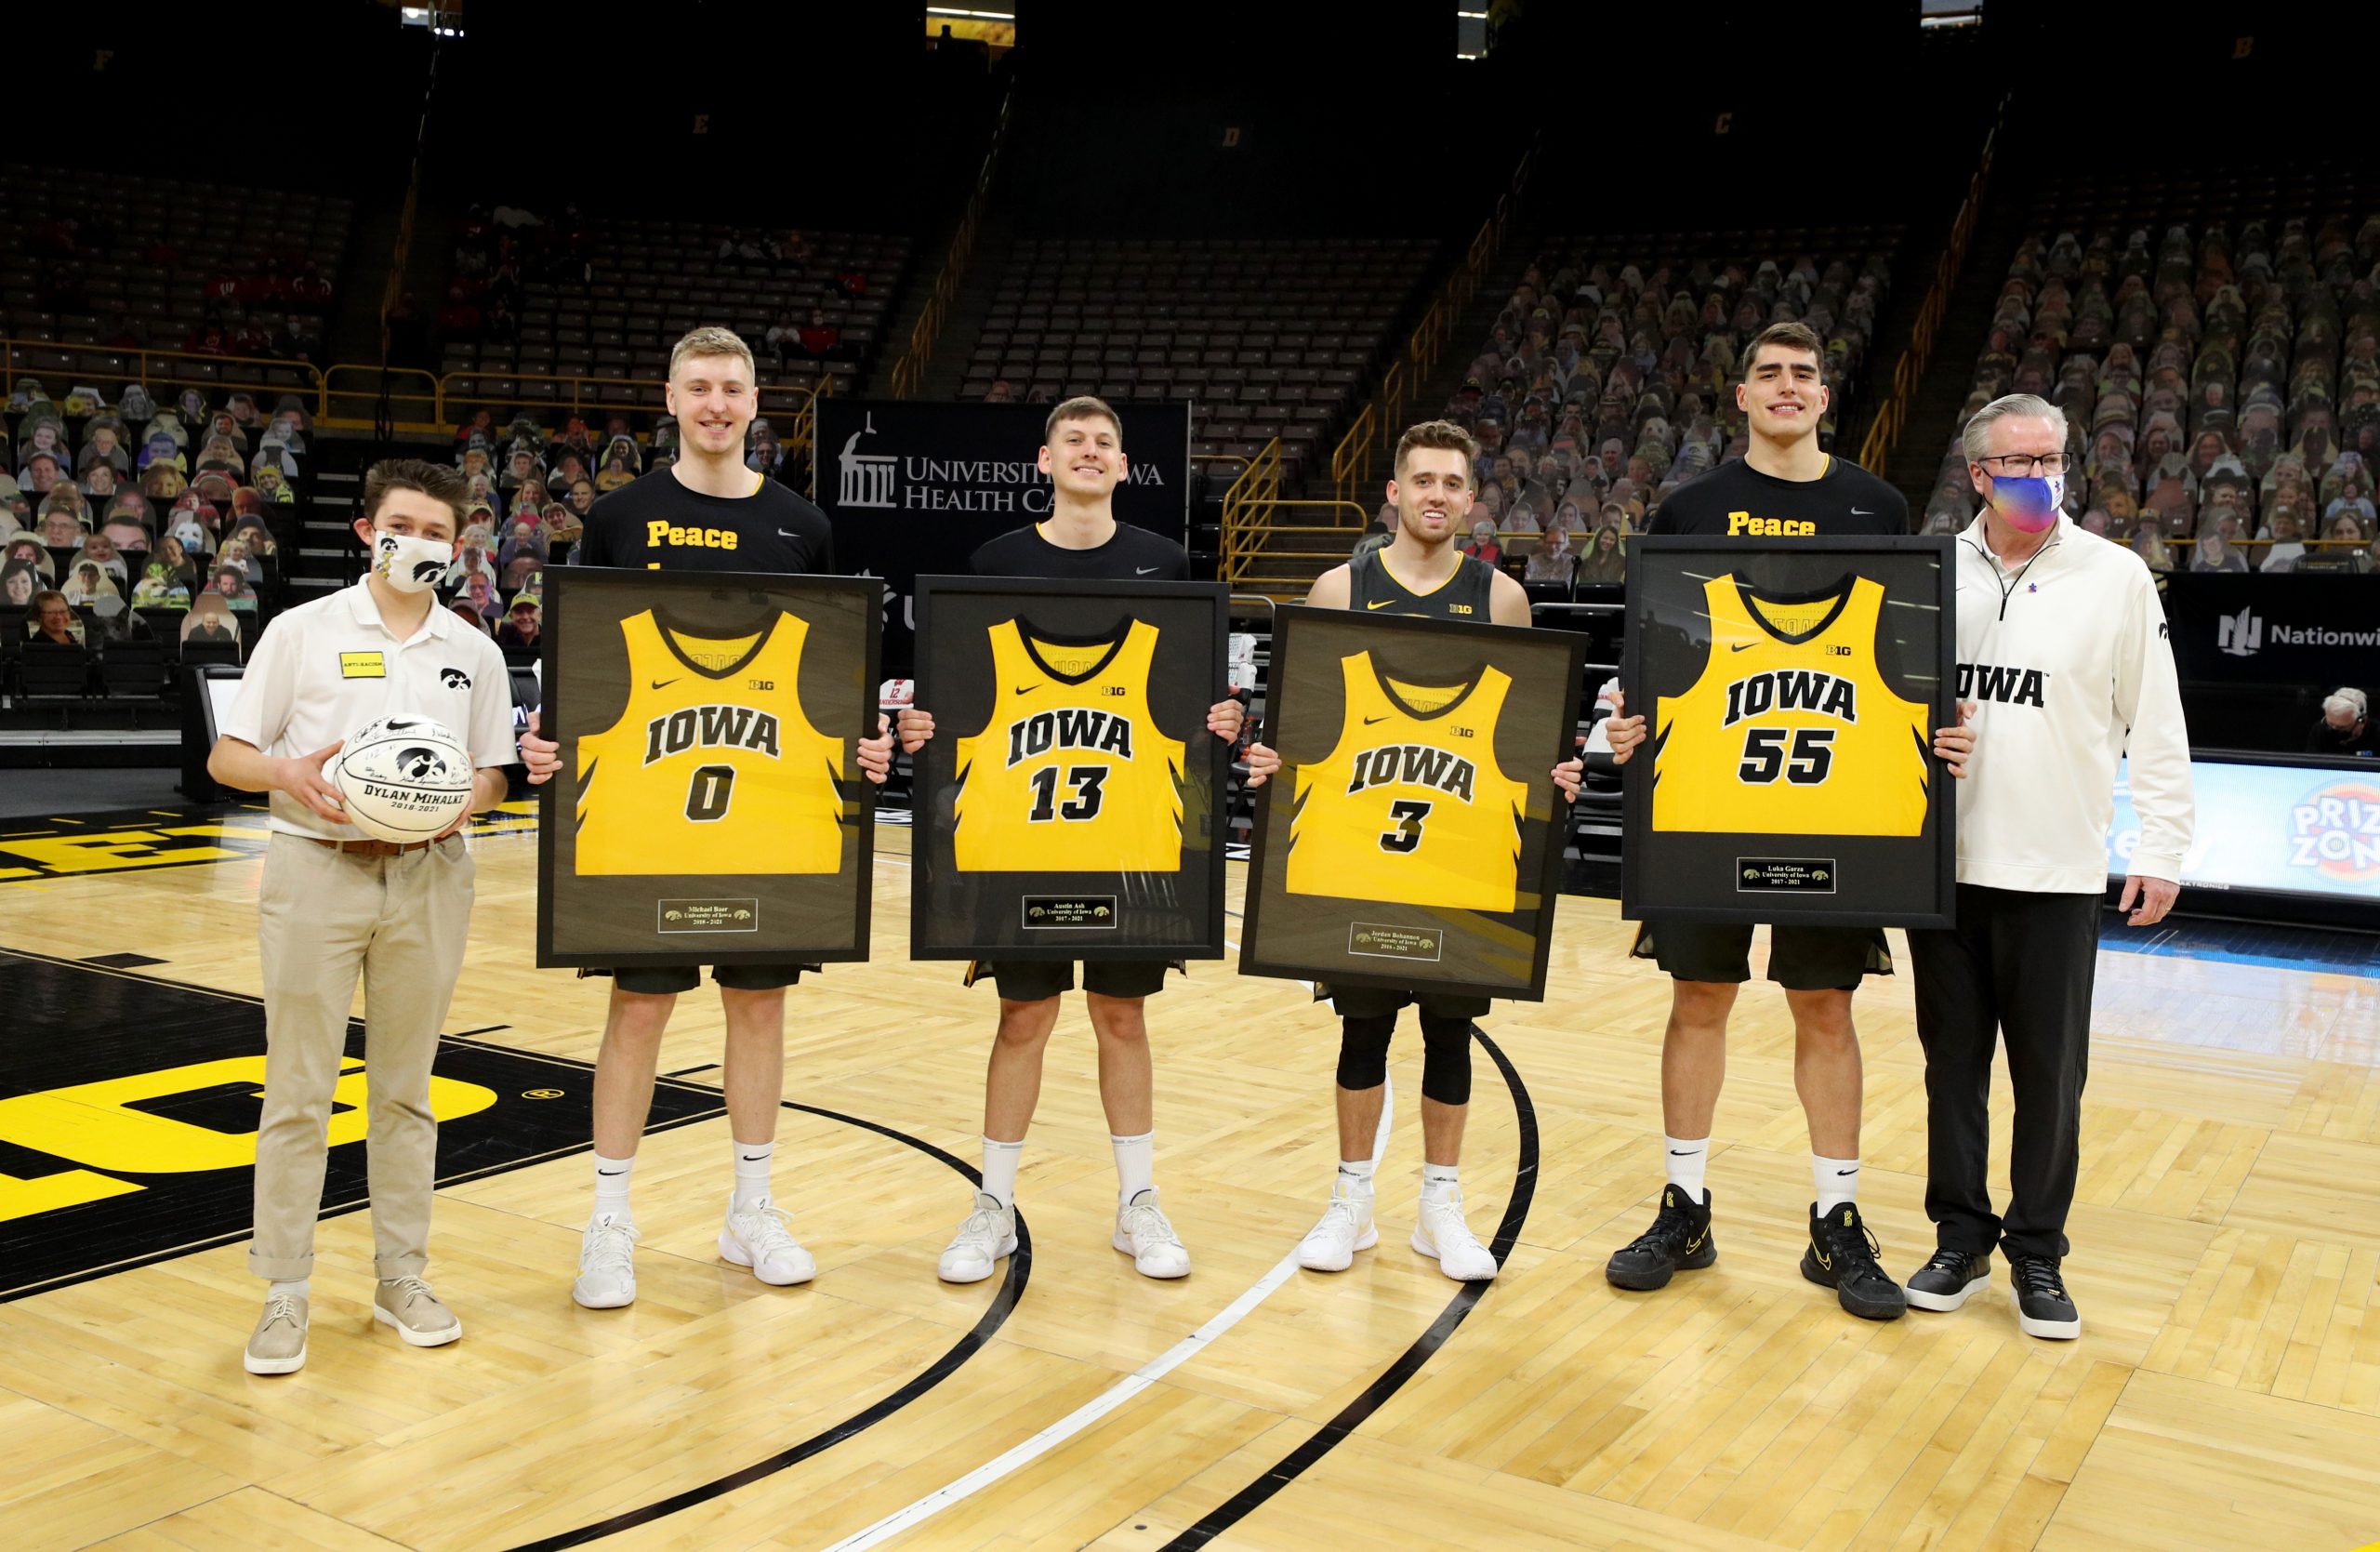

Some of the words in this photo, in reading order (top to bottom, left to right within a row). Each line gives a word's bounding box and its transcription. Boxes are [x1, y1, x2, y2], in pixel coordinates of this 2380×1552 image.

[693, 113, 710, 135] E
[1222, 126, 1241, 148] D
[904, 485, 1014, 512] HEALTH
[647, 520, 738, 550] Peace
[1727, 511, 1816, 537] Peace
[1722, 669, 1858, 730] IOWA
[641, 704, 782, 769] IOWA
[1007, 708, 1134, 770] IOWA
[1737, 726, 1837, 787] 55
[364, 784, 410, 803] DYLAN
[684, 764, 735, 823] 0
[1027, 764, 1110, 823] 13
[1347, 744, 1475, 807] IOWA
[390, 801, 440, 812] 2018-2021
[1380, 799, 1434, 854] 3
[1392, 932, 1421, 941] Bohannon
